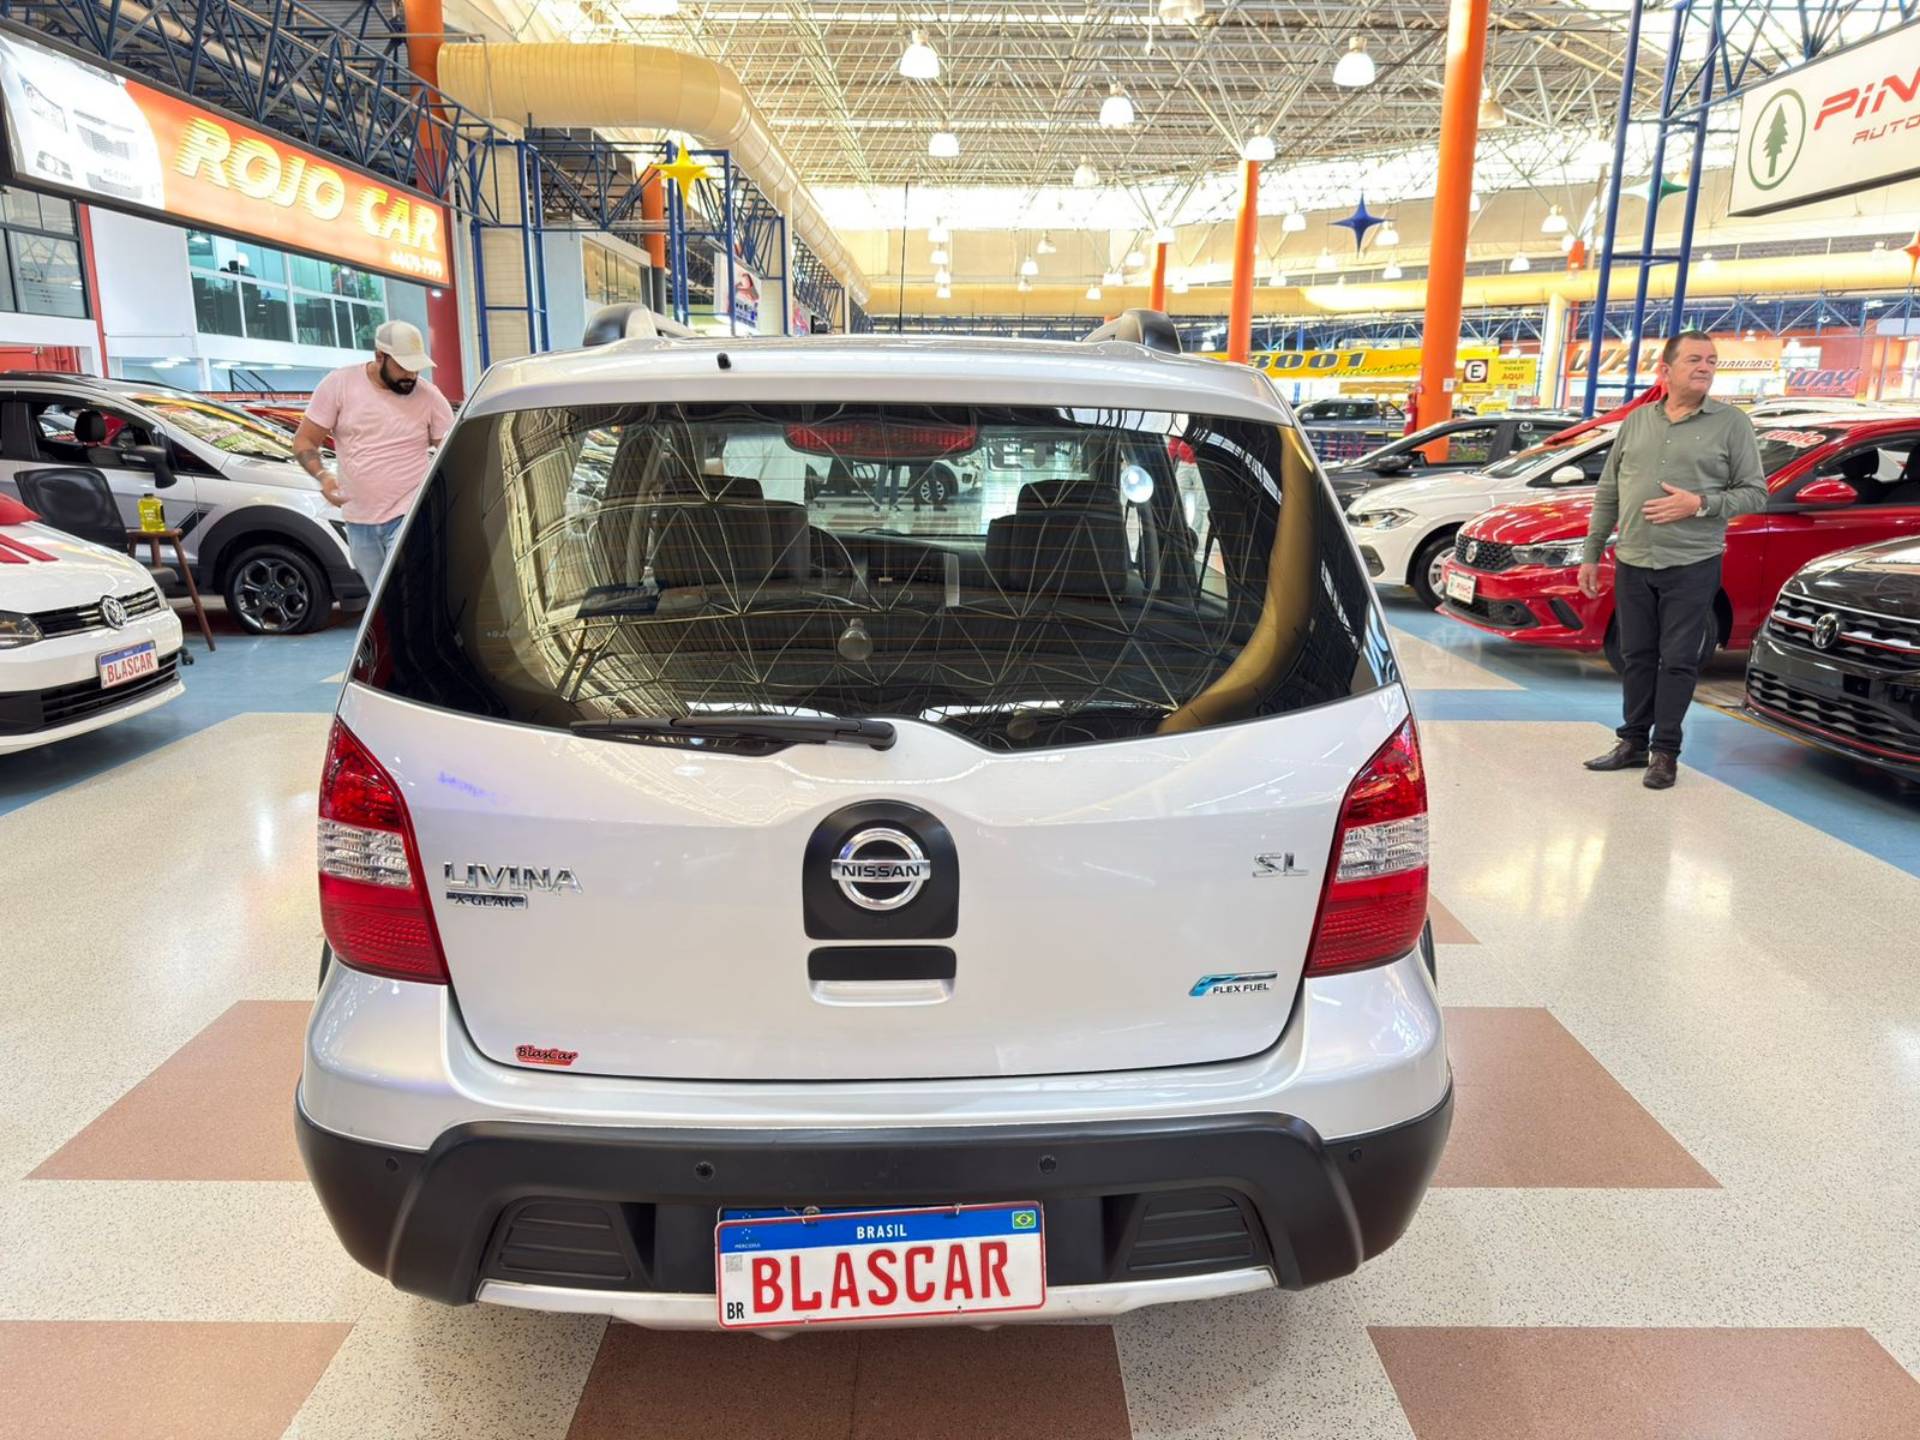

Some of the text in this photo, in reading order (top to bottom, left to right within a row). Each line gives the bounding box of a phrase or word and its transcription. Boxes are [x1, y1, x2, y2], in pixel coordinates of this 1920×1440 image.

[175, 117, 438, 252] ROJO CAR
[1471, 365, 1482, 378] E
[107, 652, 154, 683] BLASCAR
[842, 865, 919, 877] NISSAN
[1252, 853, 1309, 877] SL
[444, 861, 583, 894] LIVINA
[455, 895, 516, 907] X-GEAR
[1213, 983, 1269, 994] FLEX FUEL
[856, 1224, 907, 1239] BRASIL
[752, 1241, 1011, 1313] BLASCAR
[727, 1302, 745, 1319] BR
